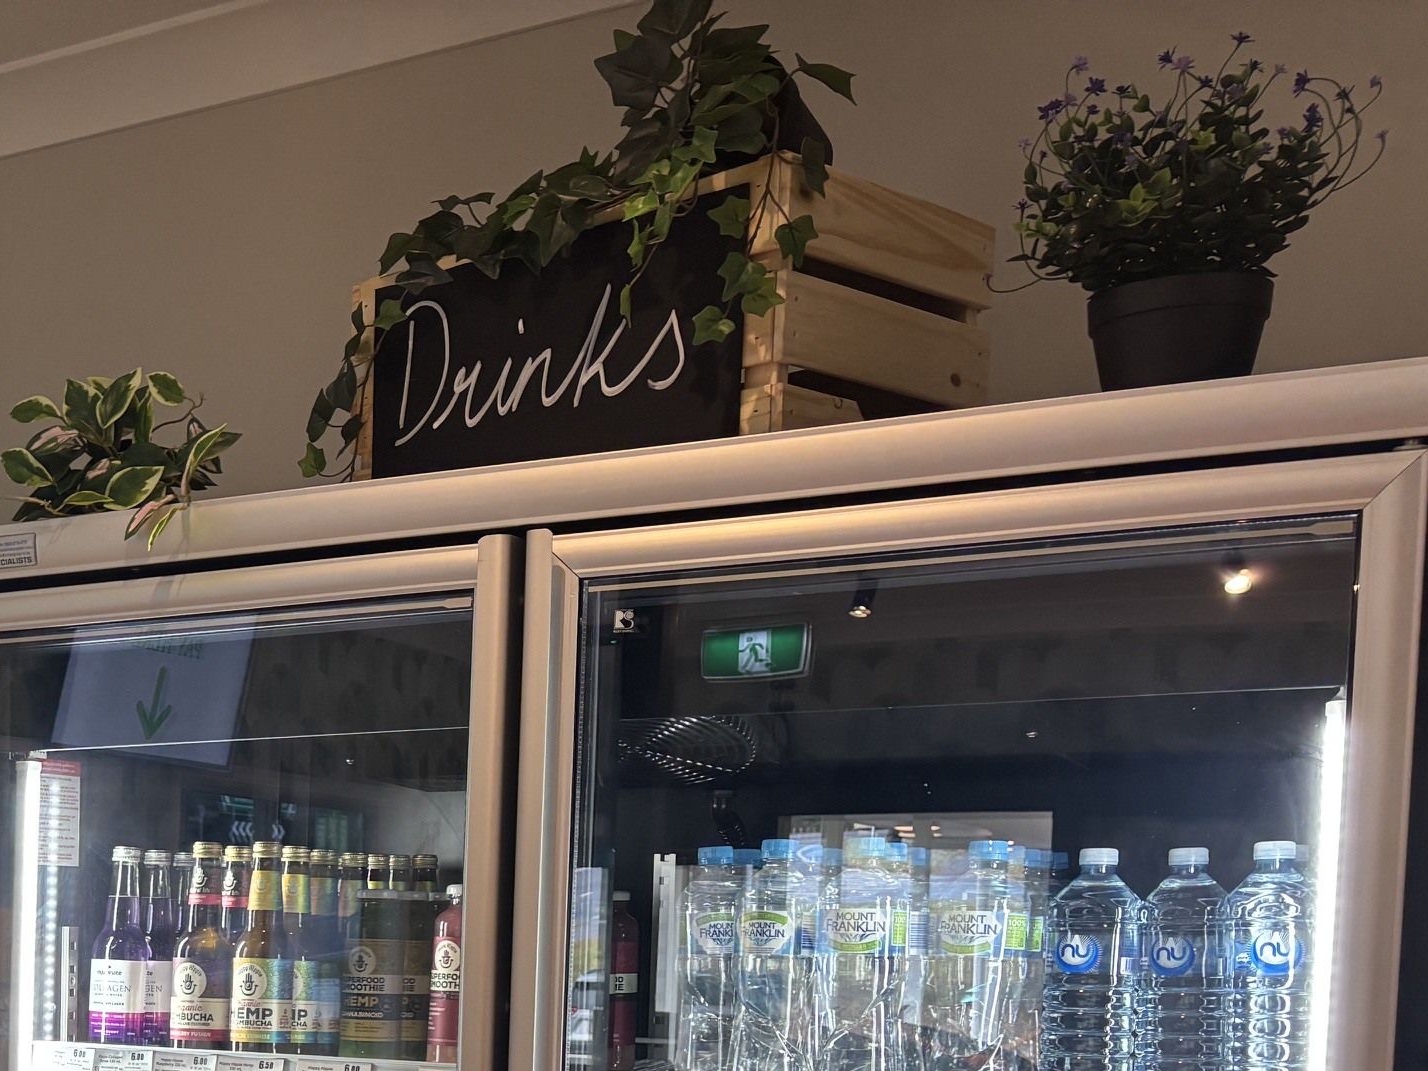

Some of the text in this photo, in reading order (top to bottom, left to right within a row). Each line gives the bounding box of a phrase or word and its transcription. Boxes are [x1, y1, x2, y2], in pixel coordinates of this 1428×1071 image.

[395, 283, 687, 446] Drinks
[835, 911, 876, 922] MOUNT
[948, 914, 987, 925] MOUNT
[748, 922, 776, 930] MOUNT
[826, 919, 886, 933] FRANKLIN
[1008, 918, 1026, 927] 100%
[741, 928, 785, 939] FRANKLIN
[939, 921, 999, 936] FRANKLIN
[1061, 942, 1089, 959] nu
[1156, 946, 1186, 962] nu
[131, 1052, 145, 1061] 6.00
[193, 1056, 208, 1066] 6.00
[258, 1060, 274, 1070] 6.50
